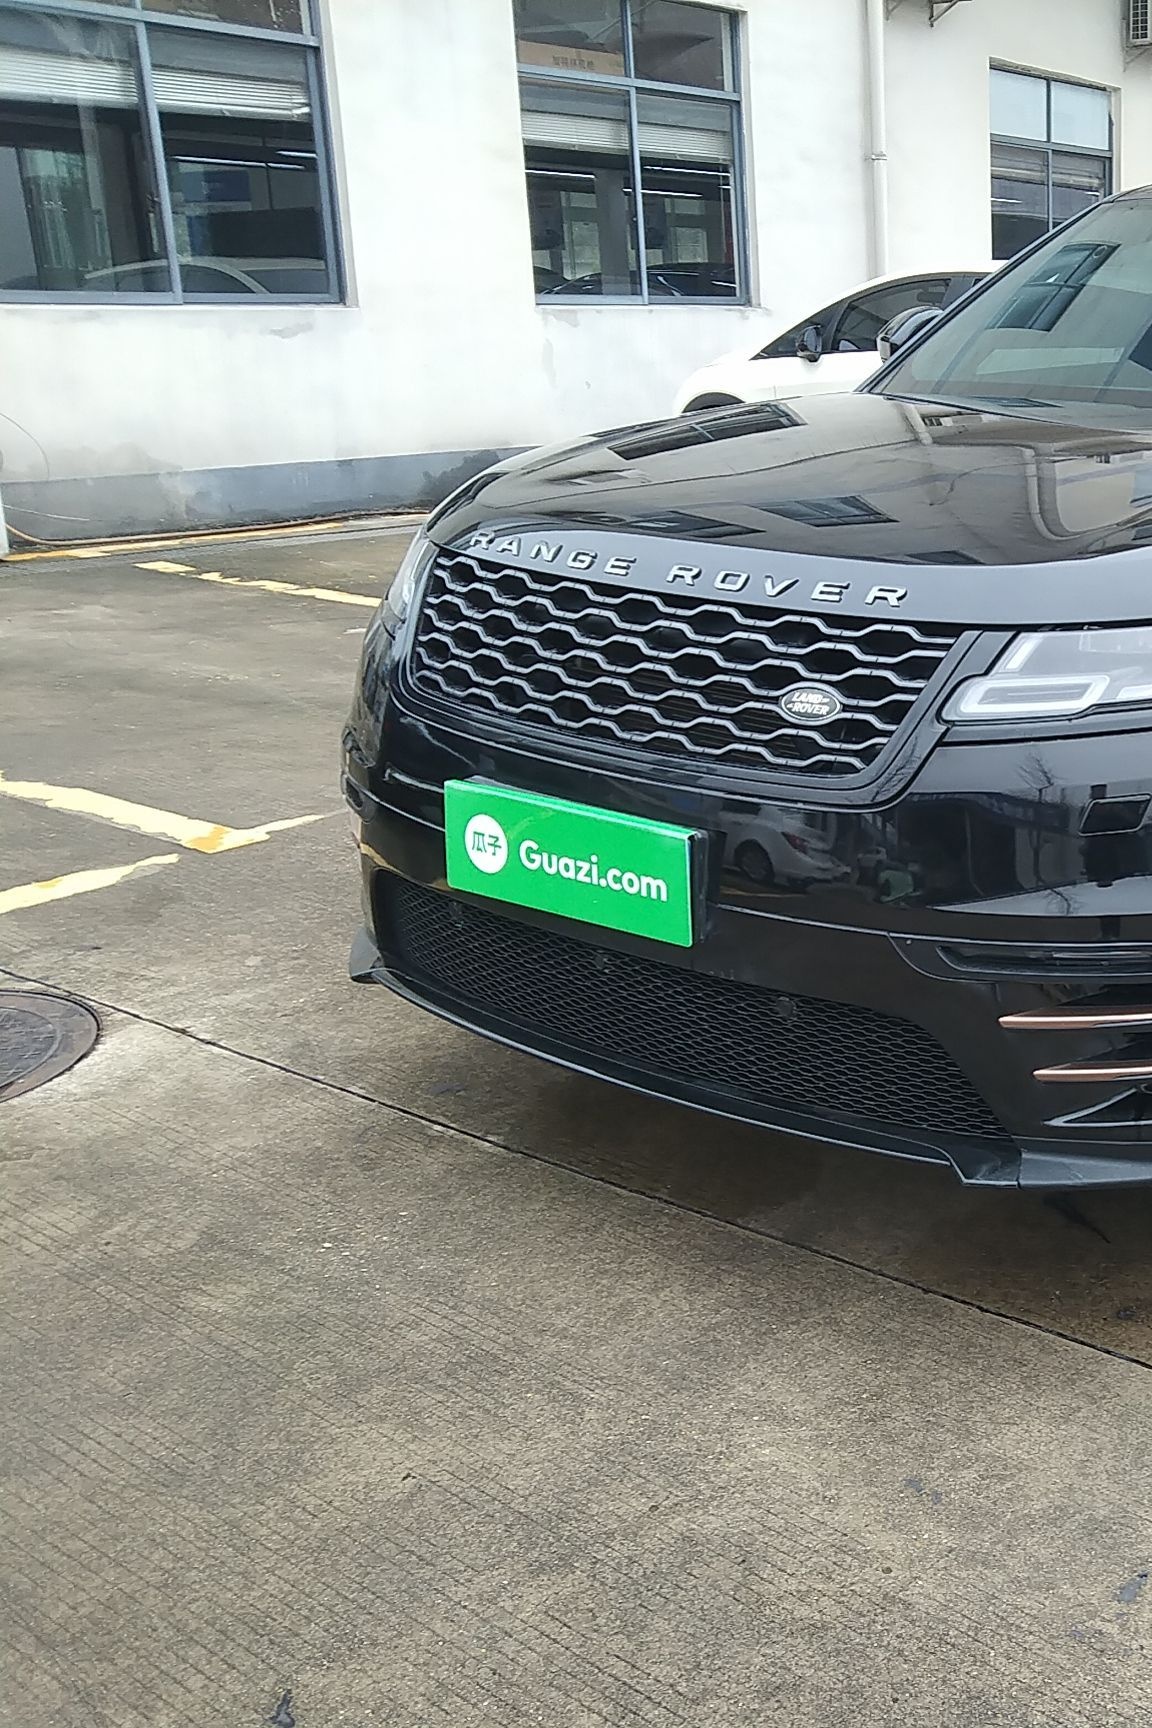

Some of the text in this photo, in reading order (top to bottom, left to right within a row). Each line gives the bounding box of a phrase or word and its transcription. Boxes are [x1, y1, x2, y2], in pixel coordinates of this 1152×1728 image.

[469, 529, 909, 608] RANGE ROVER
[792, 692, 823, 703] LAND
[792, 702, 830, 715] ROVER
[472, 831, 502, 856] 瓜子
[519, 839, 668, 902] Guazi.com
